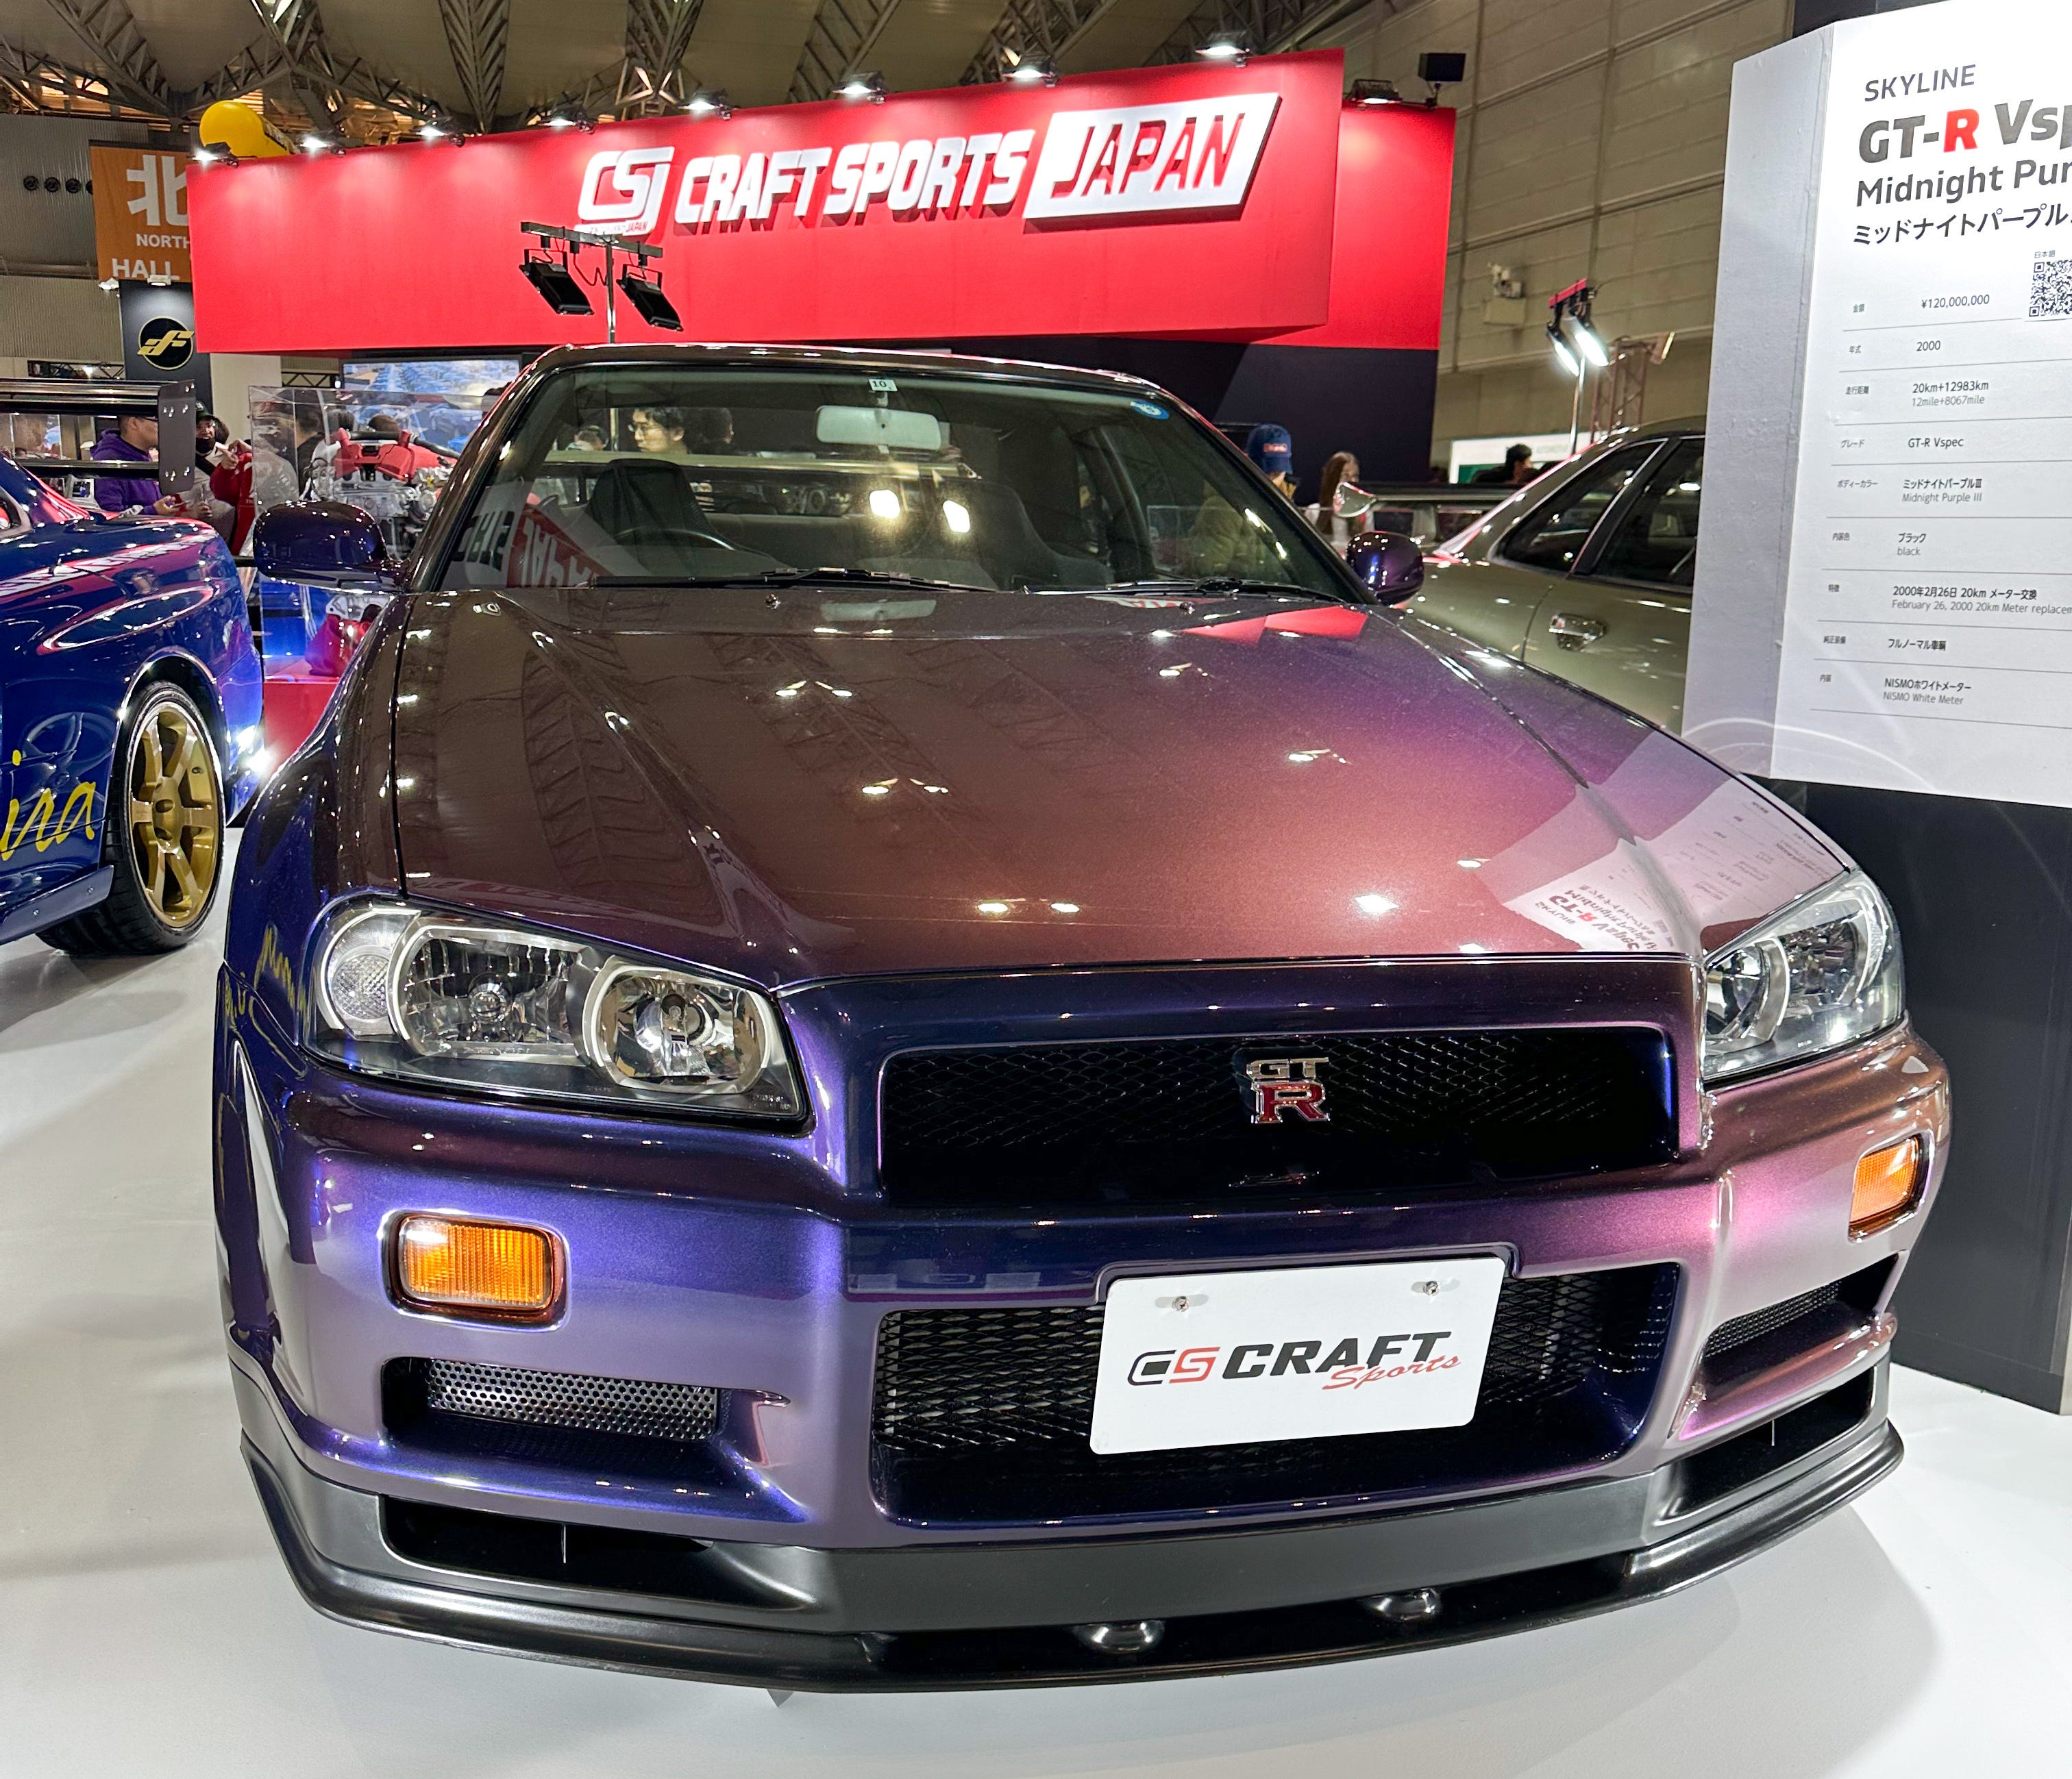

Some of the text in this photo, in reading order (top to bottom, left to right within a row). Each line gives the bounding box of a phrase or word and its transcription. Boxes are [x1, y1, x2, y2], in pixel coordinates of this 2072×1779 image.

[1864, 64, 1976, 102] SKYLINE
[1859, 108, 1980, 164] GT-R
[674, 147, 832, 223] CRAFT
[823, 129, 1036, 215] SPORTS
[1050, 112, 1246, 199] JAPAN
[1856, 165, 2003, 207] Midnight
[1853, 203, 2072, 245] ミッドナイトパープル
[1921, 294, 1990, 309] ¥120,000,000
[1916, 340, 1941, 351] 2000
[1912, 380, 1989, 394] 20km+12983km
[1912, 395, 1985, 407] 12mile+8067mile
[1908, 437, 1964, 449] GT-R Vspec
[1902, 493, 1982, 504] Midnight Purple III
[1898, 532, 1927, 543] ブラック
[1897, 547, 1921, 556] black
[1960, 587, 1986, 598] 20km
[1892, 599, 1931, 612] February
[1950, 601, 1973, 611] 2000
[1975, 602, 1999, 612] 20km
[2001, 603, 2028, 613] Meter
[1883, 691, 1964, 705] NISMO White Meter
[1222, 1331, 1452, 1380] CRAFT
[1322, 1354, 1462, 1390] Sports
